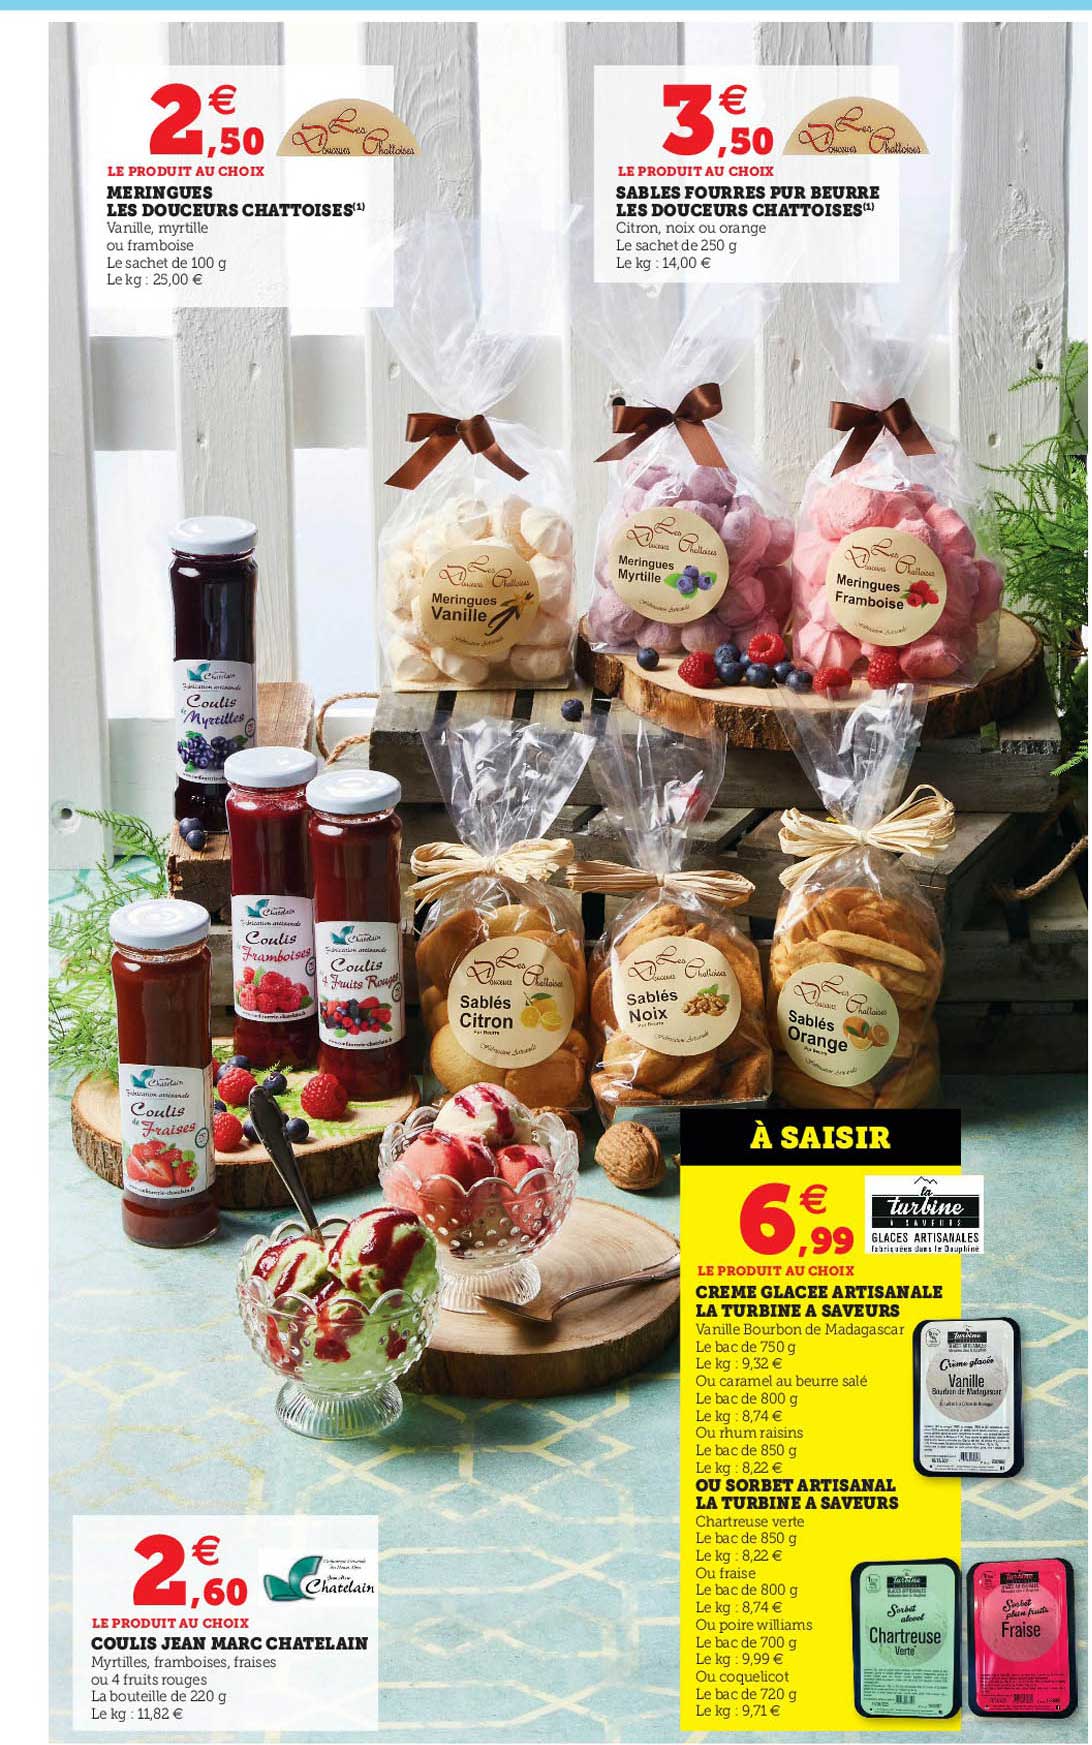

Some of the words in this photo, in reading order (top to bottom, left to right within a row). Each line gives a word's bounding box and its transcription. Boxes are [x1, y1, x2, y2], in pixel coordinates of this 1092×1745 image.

[108, 166, 124, 176] LE
[128, 166, 192, 176] PRODUIT
[195, 166, 215, 176] AU
[218, 166, 264, 176] CHOIX
[618, 166, 634, 176] LE
[638, 166, 702, 176] PRODUIT
[705, 166, 724, 176] AU
[729, 166, 774, 176] CHOIX
[107, 186, 212, 199] MERINGUES
[616, 186, 680, 199] SABLES
[685, 186, 765, 199] FOURRES
[771, 186, 805, 199] PUR
[811, 186, 879, 199] BEURRE
[107, 204, 137, 216] LES
[142, 204, 238, 216] DOUCEURS
[617, 204, 647, 216] LES
[652, 204, 747, 216] DOUCEURS
[107, 222, 153, 235] Vanille,
[159, 222, 208, 236] myrtille
[616, 222, 661, 234] Citron,
[666, 222, 695, 233] noix
[699, 225, 716, 233] ou
[720, 225, 766, 236] orange
[107, 242, 123, 251] ou
[128, 240, 193, 251] framboise
[616, 239, 632, 251] Le
[636, 240, 678, 251] sachet
[681, 239, 698, 251] de
[701, 239, 724, 251] 250
[729, 242, 736, 254] g
[107, 257, 122, 268] Le
[126, 257, 168, 268] sachet
[172, 257, 187, 268] de
[192, 257, 214, 268] 100
[219, 260, 226, 271] g
[616, 257, 632, 268] Le
[636, 257, 652, 271] kg
[663, 256, 696, 270] 14,00
[701, 257, 711, 268] €
[108, 273, 122, 285] Le
[125, 273, 141, 288] kg
[153, 273, 188, 286] 25,00
[193, 274, 203, 285] €
[618, 555, 674, 570] Meringues
[618, 568, 661, 583] Myrtille
[837, 573, 900, 593] Meringues
[432, 593, 497, 607] Meringues
[835, 591, 904, 610] Framboise
[431, 605, 488, 622] Vanille
[187, 694, 237, 708] Coulis
[184, 710, 245, 729] Myrtilles
[245, 930, 297, 945] Coulis
[239, 946, 312, 963] Framboises
[331, 958, 383, 972] Coulis
[460, 995, 511, 1009] Sablés
[626, 989, 678, 1006] Sablés
[460, 1012, 513, 1029] Citron
[629, 1007, 668, 1023] Noix
[788, 1009, 835, 1032] Sablés
[788, 1025, 848, 1054] Orange
[130, 1102, 185, 1118] Coulis
[141, 1120, 196, 1137] Fraises
[750, 1120, 772, 1149] À
[781, 1126, 891, 1149] SAISIR
[920, 1186, 933, 1196] la
[887, 1197, 964, 1215] turbine
[872, 1233, 908, 1243] GLACES
[914, 1233, 979, 1243] ARTISANALES
[699, 1266, 713, 1275] LE
[718, 1266, 781, 1275] PRODUIT
[786, 1266, 804, 1275] AU
[809, 1266, 853, 1275] CHOIX
[696, 1286, 756, 1298] CREME
[761, 1286, 827, 1298] GLACEE
[832, 1286, 942, 1298] ARTISANALE
[696, 1304, 717, 1317] LA
[721, 1304, 801, 1317] TURBINE
[805, 1304, 816, 1317] A
[822, 1304, 899, 1317] SAVEURS
[696, 1324, 740, 1335] Vanille
[744, 1324, 802, 1336] Bourbon
[806, 1323, 820, 1336] de
[825, 1323, 904, 1337] Madagascar
[948, 1374, 985, 1388] Vanille
[696, 1478, 721, 1492] OU
[726, 1478, 793, 1493] SORBET
[797, 1478, 896, 1493] ARTISANAL
[305, 1578, 374, 1595] Chatelain
[92, 1618, 108, 1628] LE
[112, 1618, 176, 1628] PRODUIT
[179, 1618, 198, 1628] AU
[203, 1618, 249, 1628] CHOIX
[1001, 1621, 1041, 1638] Fraise
[869, 1626, 942, 1644] Chartreuse
[91, 1637, 156, 1650] COULIS
[162, 1637, 206, 1650] JEAN
[211, 1637, 262, 1650] MARC
[266, 1637, 368, 1650] CHATELAIN
[91, 1656, 149, 1670] Myrtilles,
[155, 1656, 230, 1669] framboises,
[234, 1657, 276, 1667] fraises
[91, 1676, 108, 1685] ou
[112, 1674, 119, 1685] 4
[124, 1674, 158, 1685] fruits
[162, 1676, 207, 1688] rouges
[92, 1690, 106, 1702] La
[110, 1690, 167, 1702] bouteille
[171, 1690, 186, 1702] de
[191, 1690, 214, 1702] 220
[219, 1693, 226, 1704] g
[92, 1708, 107, 1719] Le
[111, 1708, 126, 1722] kg
[138, 1707, 169, 1721] 11,82
[173, 1708, 182, 1719] €
